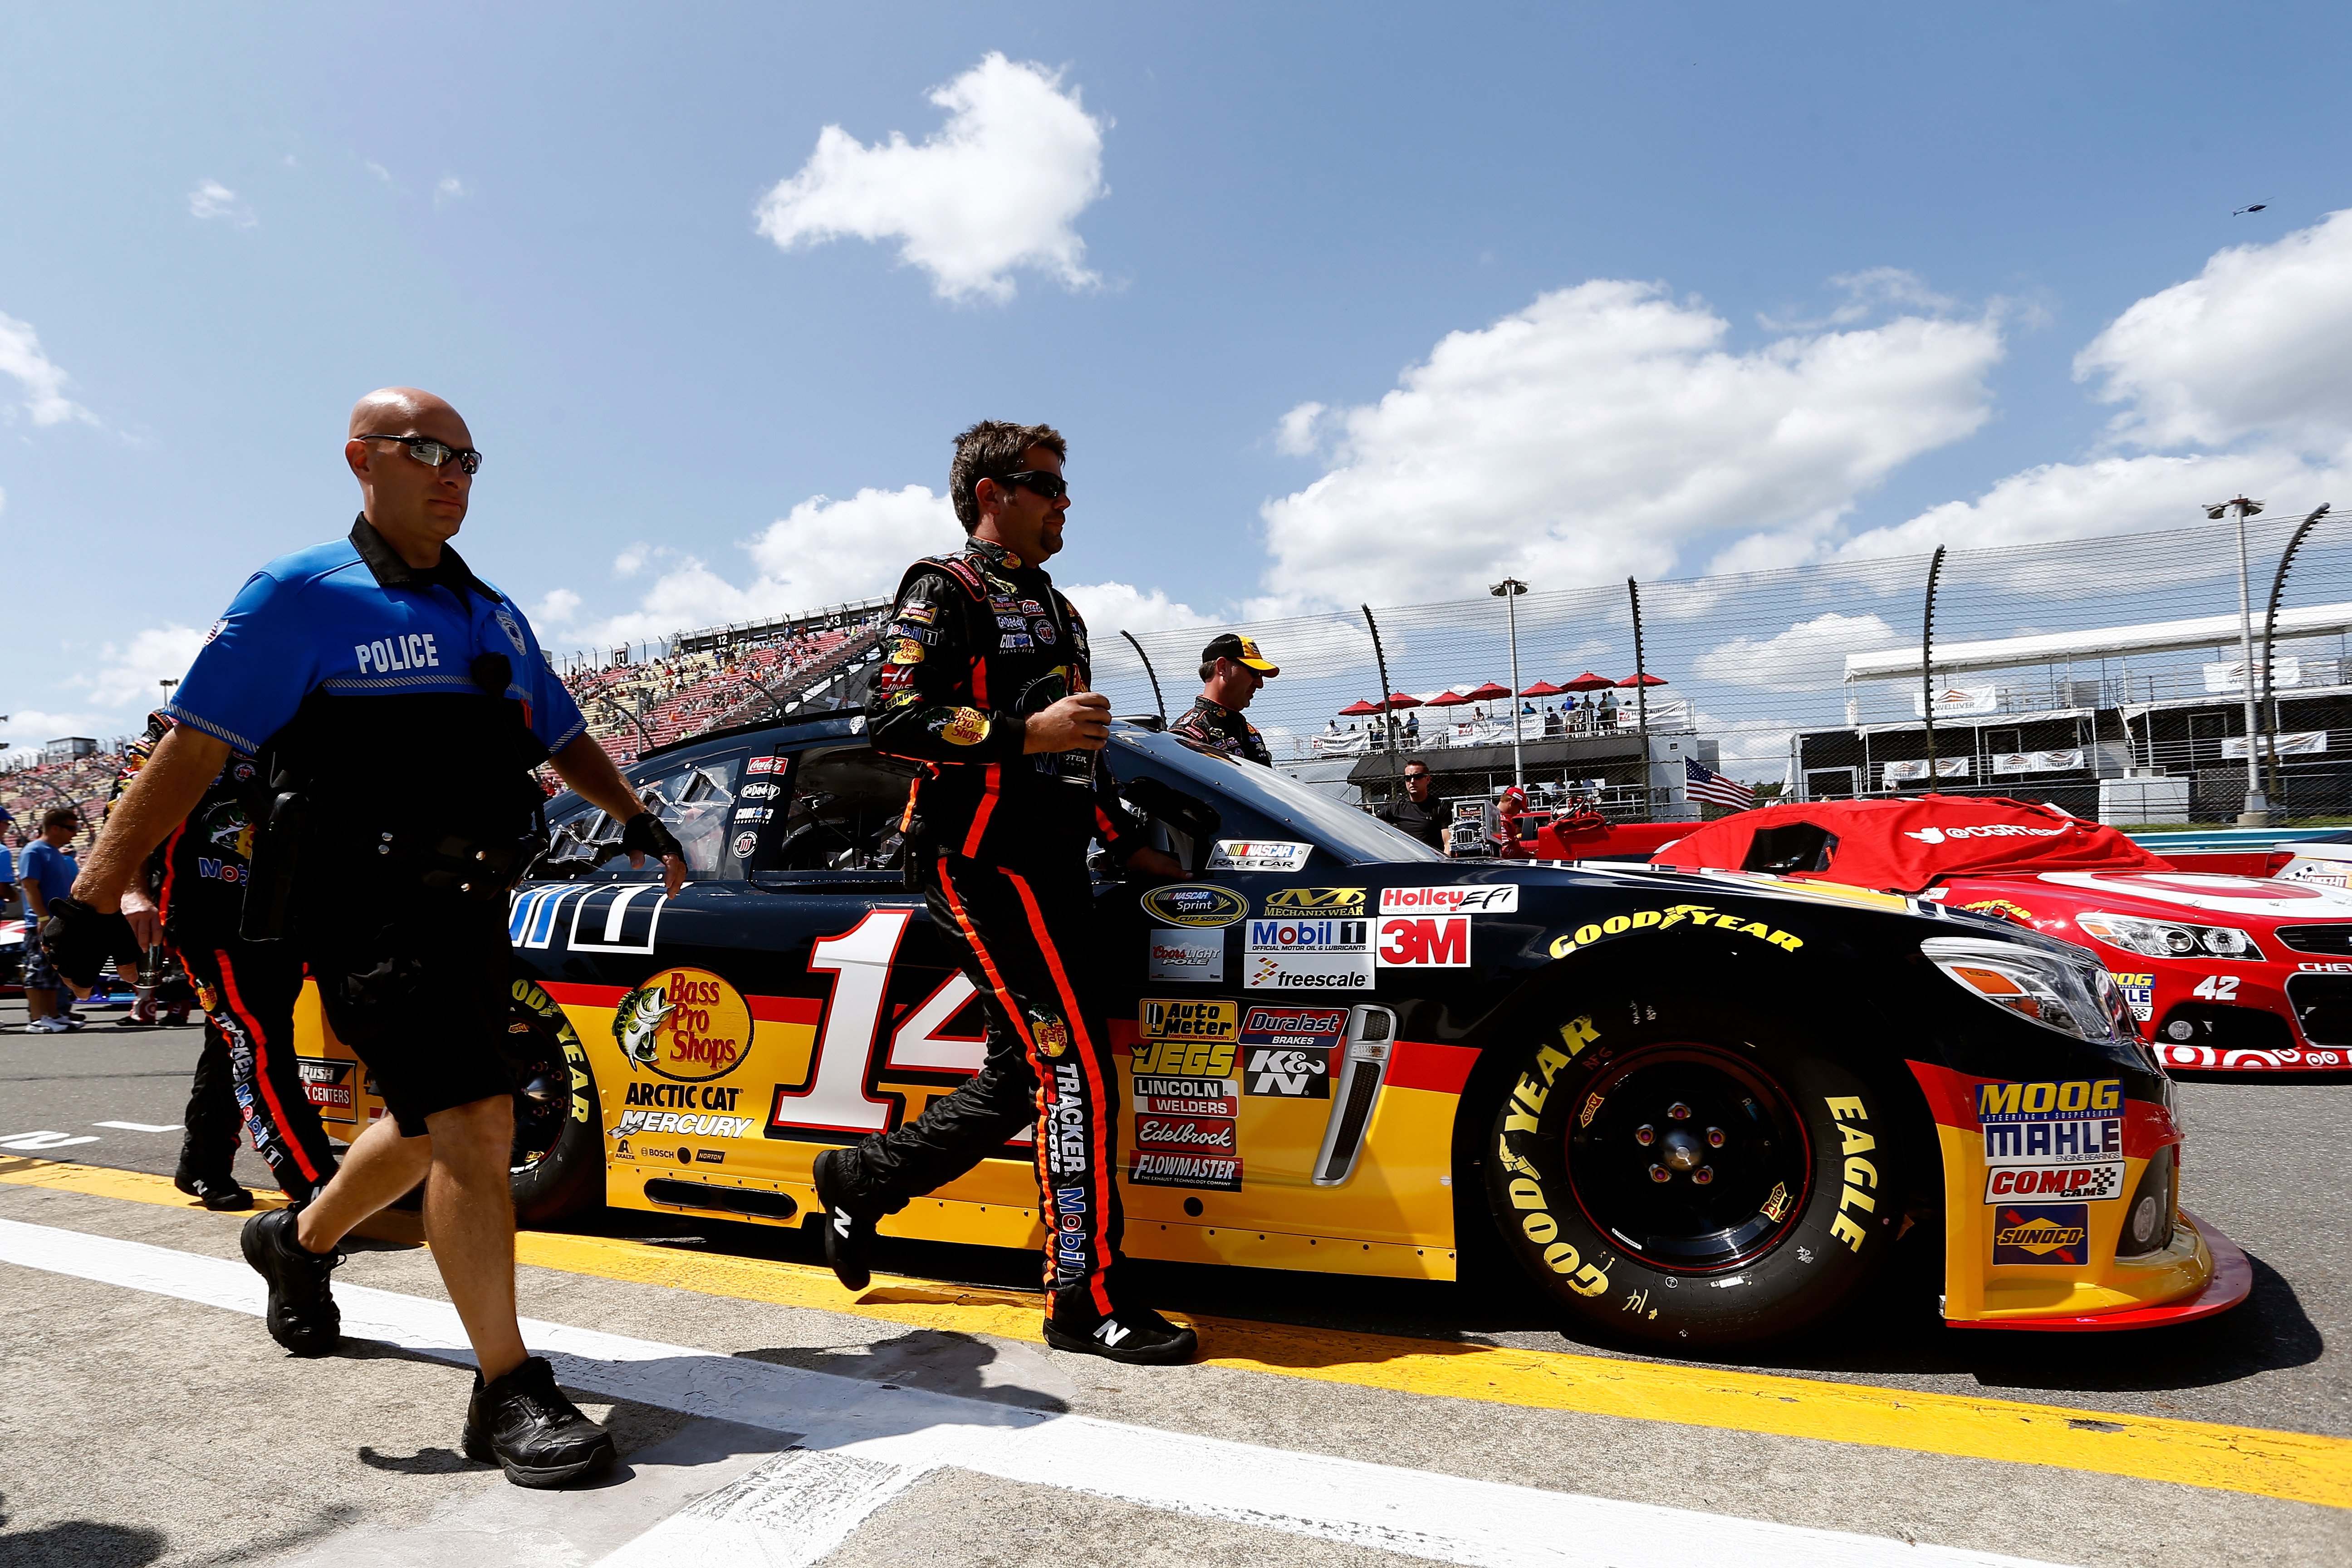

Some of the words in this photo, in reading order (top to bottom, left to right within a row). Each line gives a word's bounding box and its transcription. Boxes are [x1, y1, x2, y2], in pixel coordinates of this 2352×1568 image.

[355, 634, 439, 674] POLICE
[900, 639, 921, 649] Bass
[900, 652, 921, 662] Shops
[956, 707, 983, 721] Bass
[1936, 702, 1975, 710] WELLIVER
[955, 717, 974, 728] Pro
[951, 726, 983, 742] Shops
[735, 808, 756, 819] CODE
[765, 808, 774, 819] 3
[1245, 845, 1292, 857] NASCAR
[1259, 859, 1295, 867] CAR
[1177, 900, 1212, 910] Sprint
[1382, 888, 1464, 911] Holley
[1459, 887, 1514, 910] EFI
[1264, 906, 1328, 916] MECHANIX
[1328, 905, 1365, 916] WEAR
[1252, 921, 1332, 945] Mobil
[1380, 918, 1467, 965] 3M
[1152, 946, 1187, 959] Coors
[1185, 950, 1221, 959] LIGHT
[666, 972, 720, 1004] Bass
[1278, 971, 1367, 987] freescale
[2193, 975, 2240, 1000] 42
[669, 1003, 710, 1032] Pro
[1166, 1003, 1221, 1019] Auto
[1164, 1018, 1233, 1036] Meter
[1249, 1012, 1340, 1033] Duralast
[1054, 1023, 1067, 1047] Bass
[1271, 1036, 1315, 1045] BRAKES
[670, 1030, 737, 1069] Shops
[1132, 1043, 1237, 1077] JEGS
[312, 1087, 349, 1104] CENTERS
[625, 1083, 697, 1109] ARCTIC
[701, 1085, 740, 1112] CAT
[1138, 1079, 1219, 1098] LINCOLN
[1979, 1079, 2120, 1116] MOOG
[235, 1083, 269, 1149] Mobil
[1156, 1099, 1228, 1114] WELDERS
[1583, 1098, 1597, 1121] AERO
[1986, 1112, 2035, 1122] STEERING
[2055, 1109, 2114, 1120] SUSPENSION
[619, 1110, 755, 1139] MERCURY
[1056, 1063, 1086, 1172] TRACKER
[1047, 1103, 1061, 1173] boats
[1139, 1120, 1233, 1147] Edelbrock
[1985, 1120, 2121, 1157] MAHLE
[649, 1149, 675, 1158] BOSCH
[2055, 1154, 2084, 1162] ENGINE
[2084, 1152, 2120, 1161] BEARINGS
[1133, 1154, 1236, 1180] FLOWMASTER
[1824, 1095, 1878, 1253] EAGLE
[1991, 1169, 2092, 1195] COMP
[2059, 1186, 2107, 1198] CAMS
[1768, 1189, 1783, 1215] AERO
[1057, 1186, 1086, 1269] Mobil
[1997, 1228, 2082, 1245] SUNOCO
